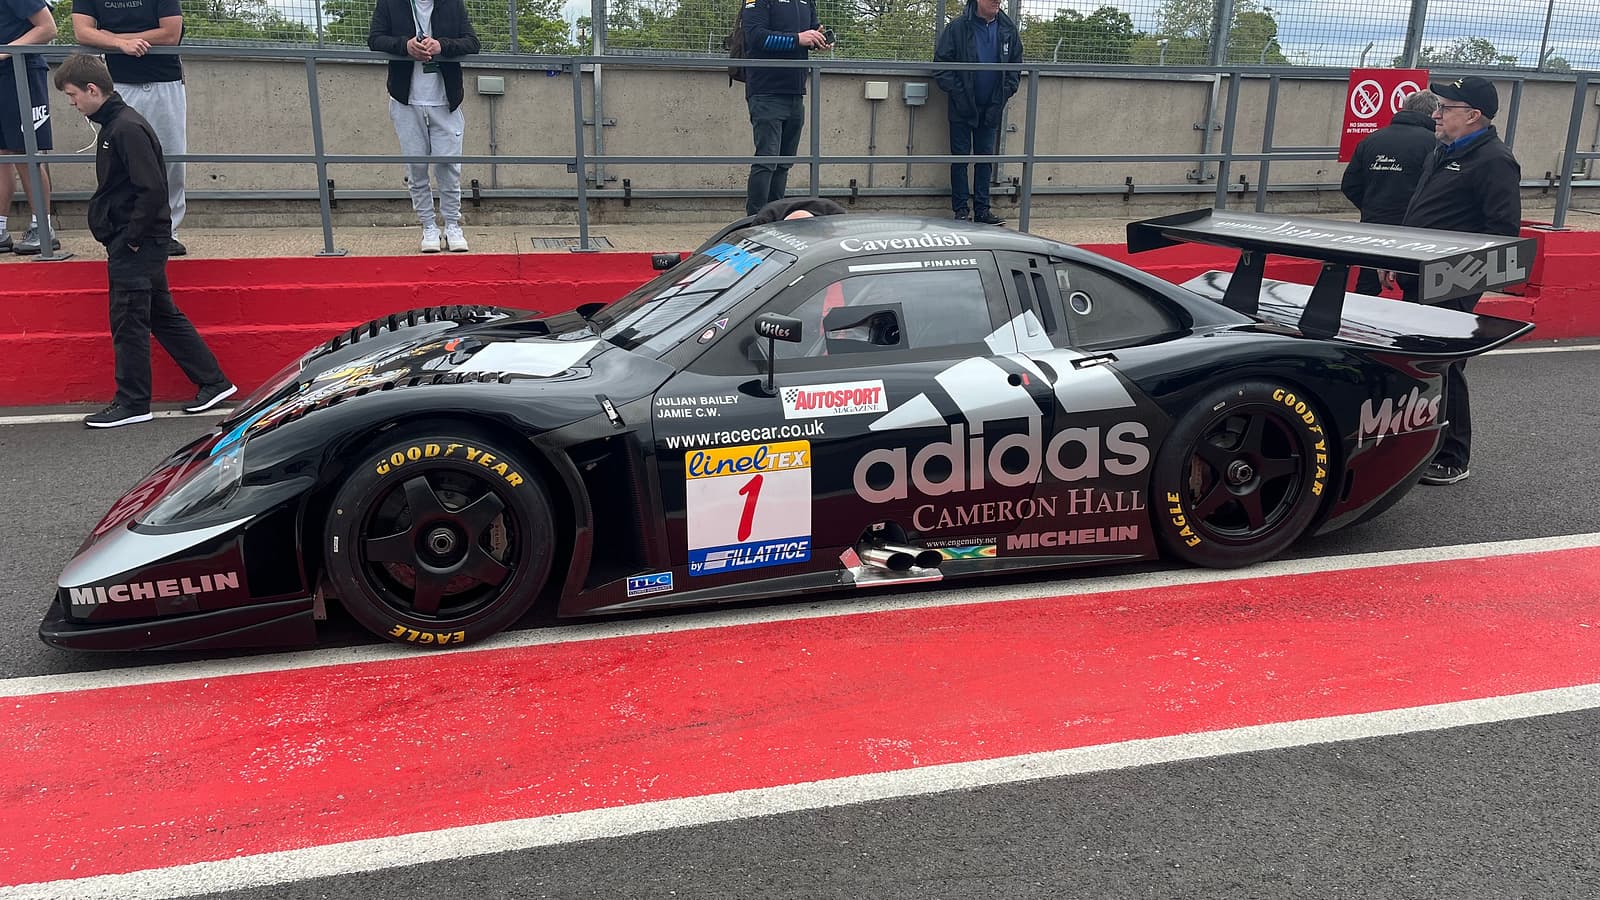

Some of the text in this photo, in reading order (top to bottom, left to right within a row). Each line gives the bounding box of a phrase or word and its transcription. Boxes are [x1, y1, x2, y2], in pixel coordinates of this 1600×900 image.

[840, 232, 972, 253] Cavendish
[923, 258, 977, 268] FINANCE
[1424, 246, 1526, 301] DELL
[760, 320, 790, 337] Miles
[656, 395, 739, 407] JULIAN BAILEY
[795, 386, 882, 410] AUTOSPORT
[833, 404, 879, 414] MAGAZINE
[657, 407, 721, 418] JAMIE C.W.
[1358, 386, 1442, 448] Miles
[666, 419, 825, 449] www.racecar.co.uk
[853, 415, 1150, 504] adidas
[737, 474, 764, 542] 1
[913, 487, 1146, 532] CAMERON HALL
[1167, 491, 1202, 548] EAGLE
[926, 537, 997, 548] www.engenuity.net
[1007, 525, 1138, 550] MICHELIN
[691, 541, 808, 571] by FILLATTICE
[69, 571, 239, 605] MICHELIN
[630, 575, 669, 587] TLC
[389, 624, 465, 645] EAGLE
